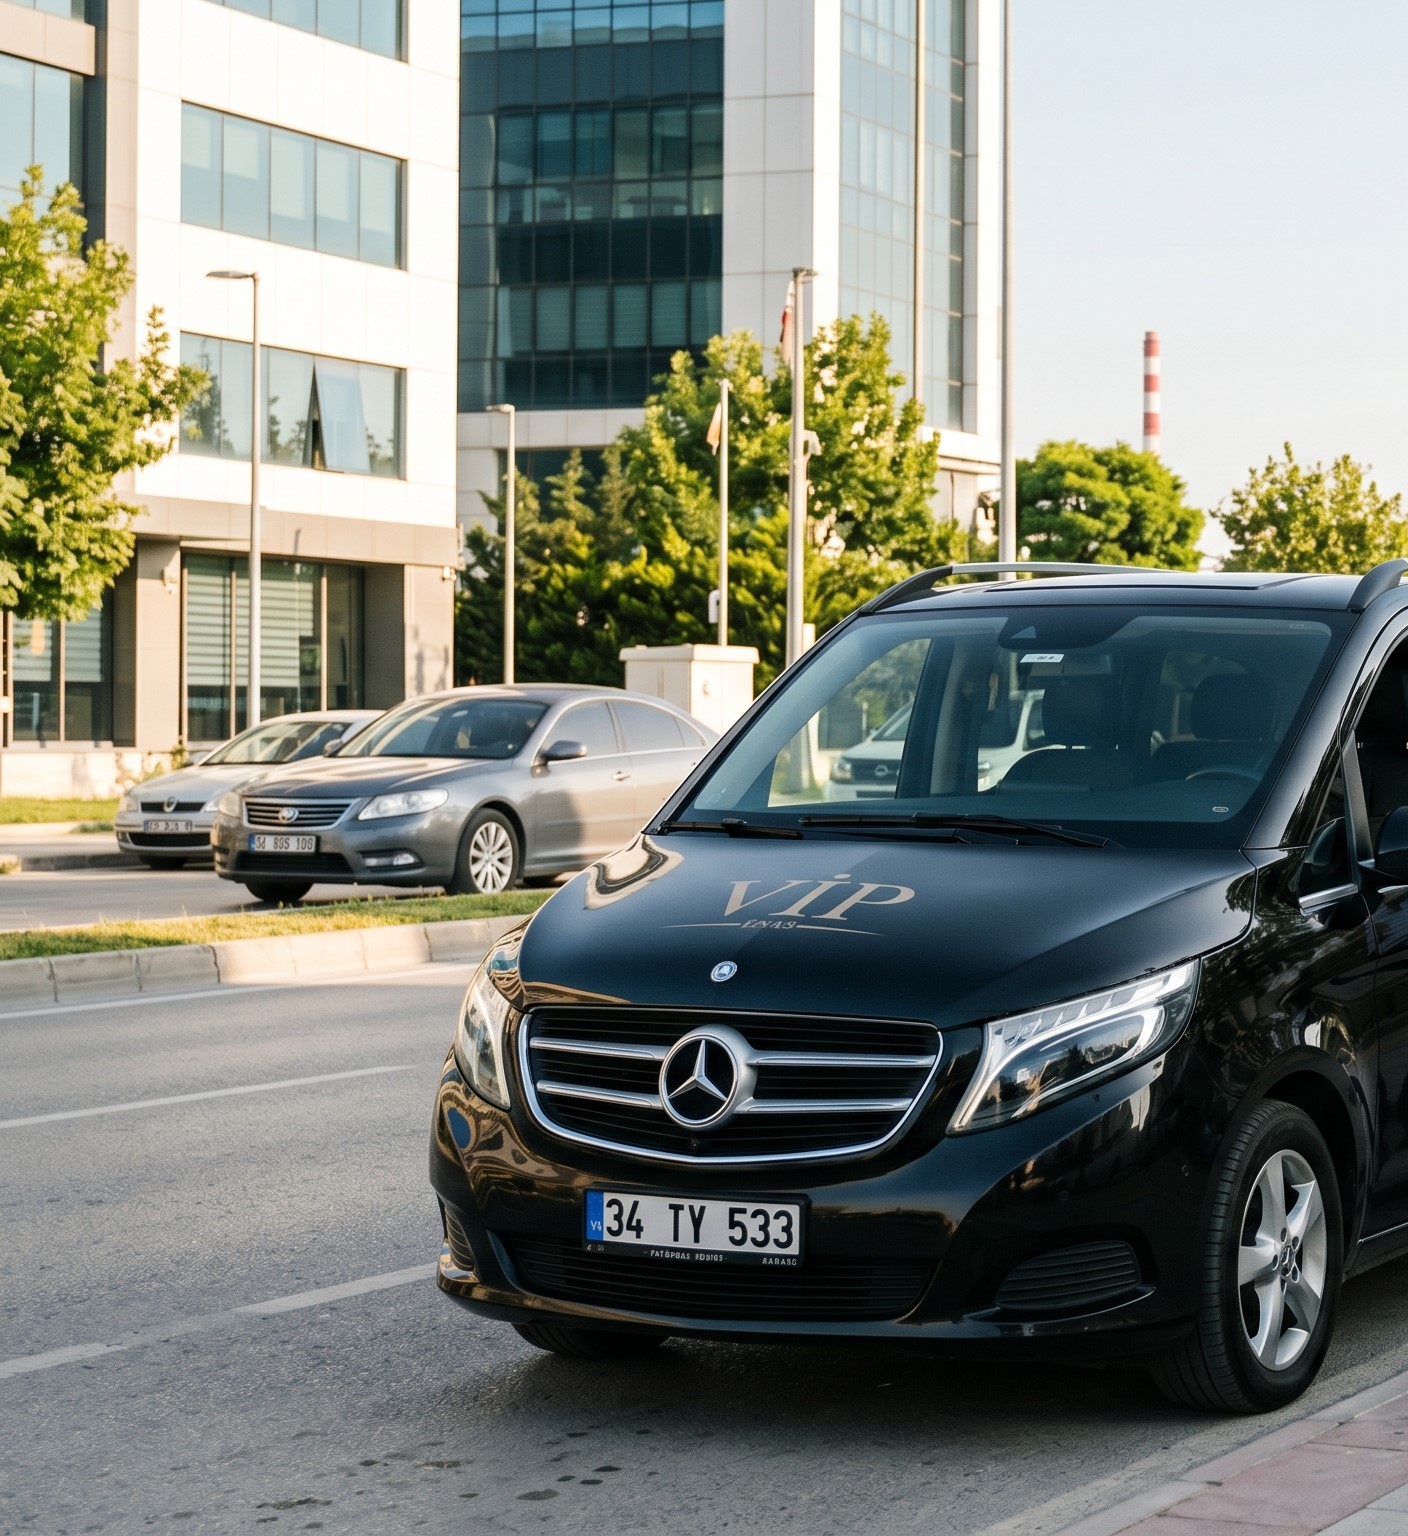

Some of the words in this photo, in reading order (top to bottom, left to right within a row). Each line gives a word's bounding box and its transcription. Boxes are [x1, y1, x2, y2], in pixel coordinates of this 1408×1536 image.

[606, 1198, 644, 1239] 34
[668, 1203, 706, 1244] TY
[728, 1207, 793, 1249] 533
